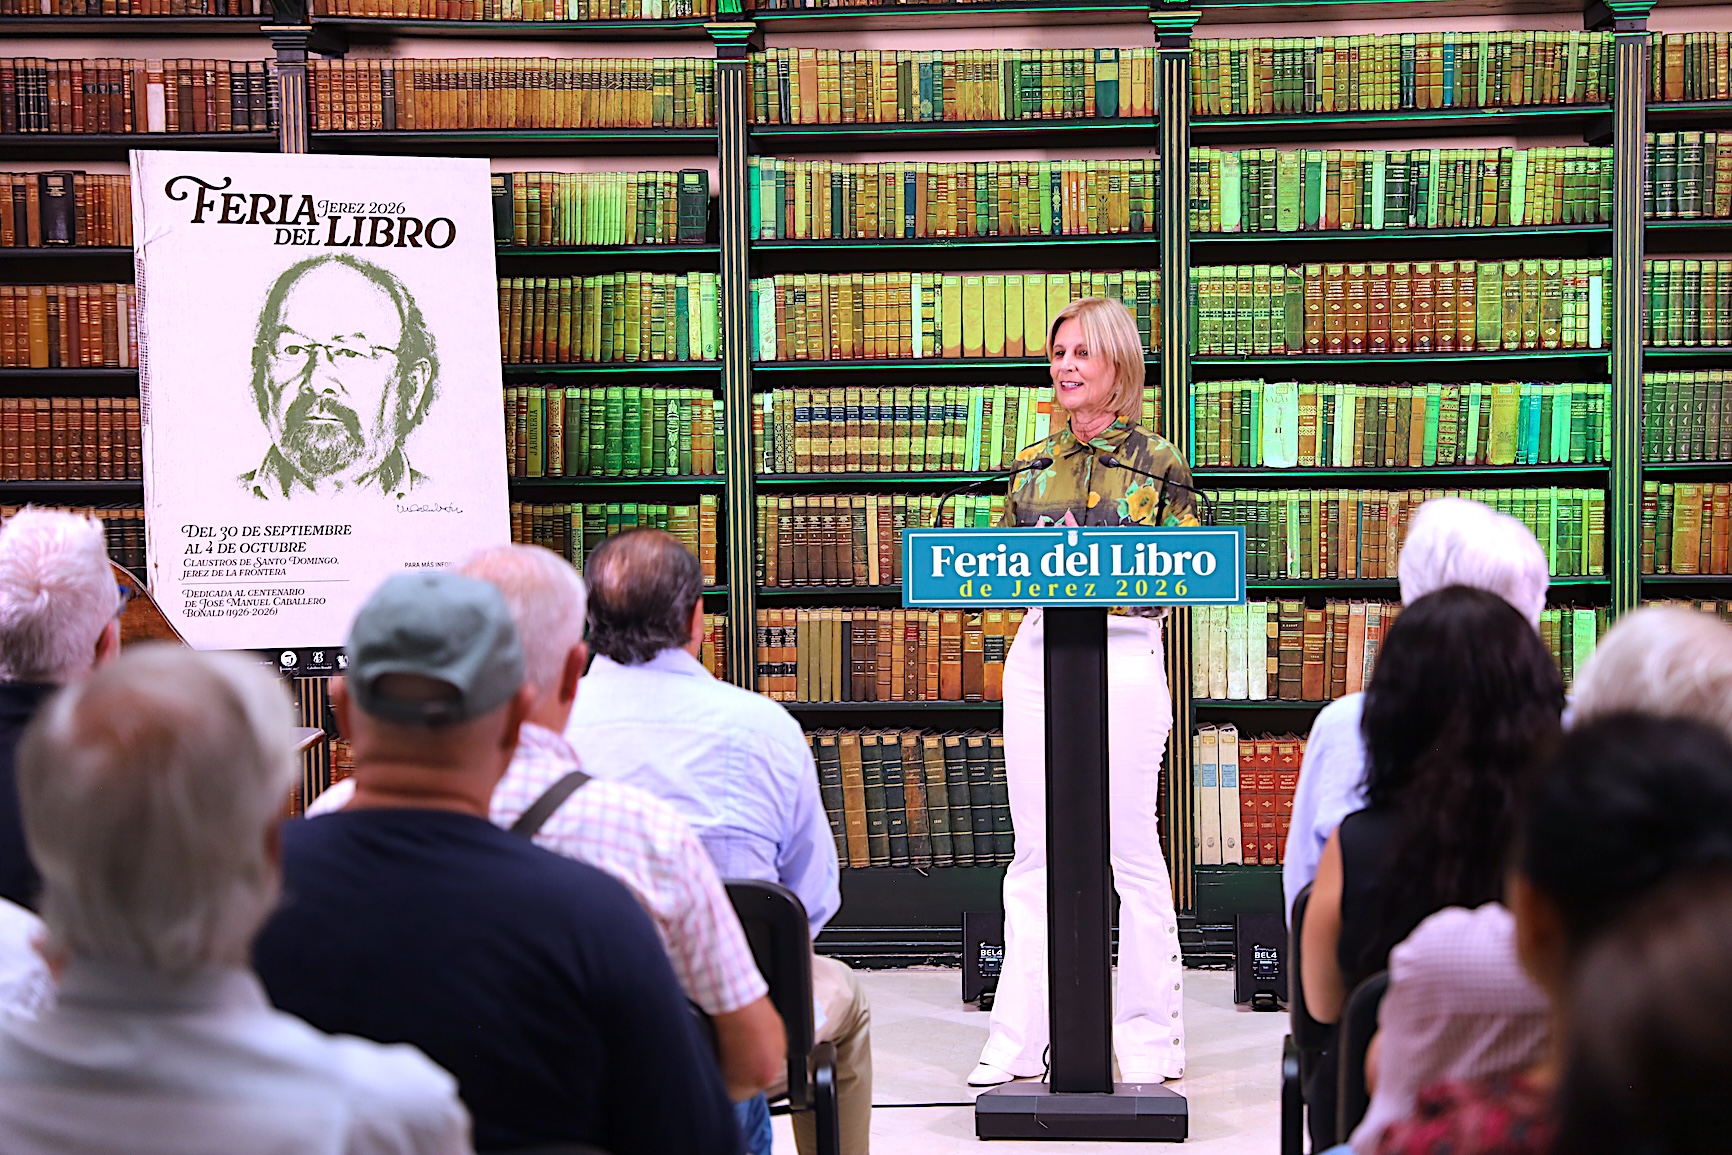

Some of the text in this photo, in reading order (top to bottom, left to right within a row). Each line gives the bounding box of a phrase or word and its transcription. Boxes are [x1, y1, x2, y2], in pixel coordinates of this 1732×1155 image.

[165, 175, 320, 226] FERIA
[317, 200, 406, 217] JEREZ 2026
[274, 215, 457, 249] DEL LIBRO
[529, 409, 538, 456] JARDINERIA
[181, 524, 352, 542] DEL 30 DE SEPTIEMBRE
[184, 540, 307, 554] AL 4 DE OCTUBRE
[183, 558, 238, 568] CLAUSTROS
[239, 558, 252, 566] DE
[253, 556, 287, 569] SANTO
[421, 560, 434, 568] MÁS
[930, 542, 1217, 578] Feria del Libro
[178, 568, 287, 581] JEREZ DE LA FRONTERA
[182, 588, 306, 598] DEDICADA AL CENTENARIO
[958, 579, 1189, 598] de Jerez 2026
[184, 600, 198, 608] DE
[226, 597, 271, 607] MANUEL
[273, 597, 327, 606] CABALLERO
[182, 607, 279, 618] BONALD (1926-2026)
[1254, 951, 1278, 959] BEL4
